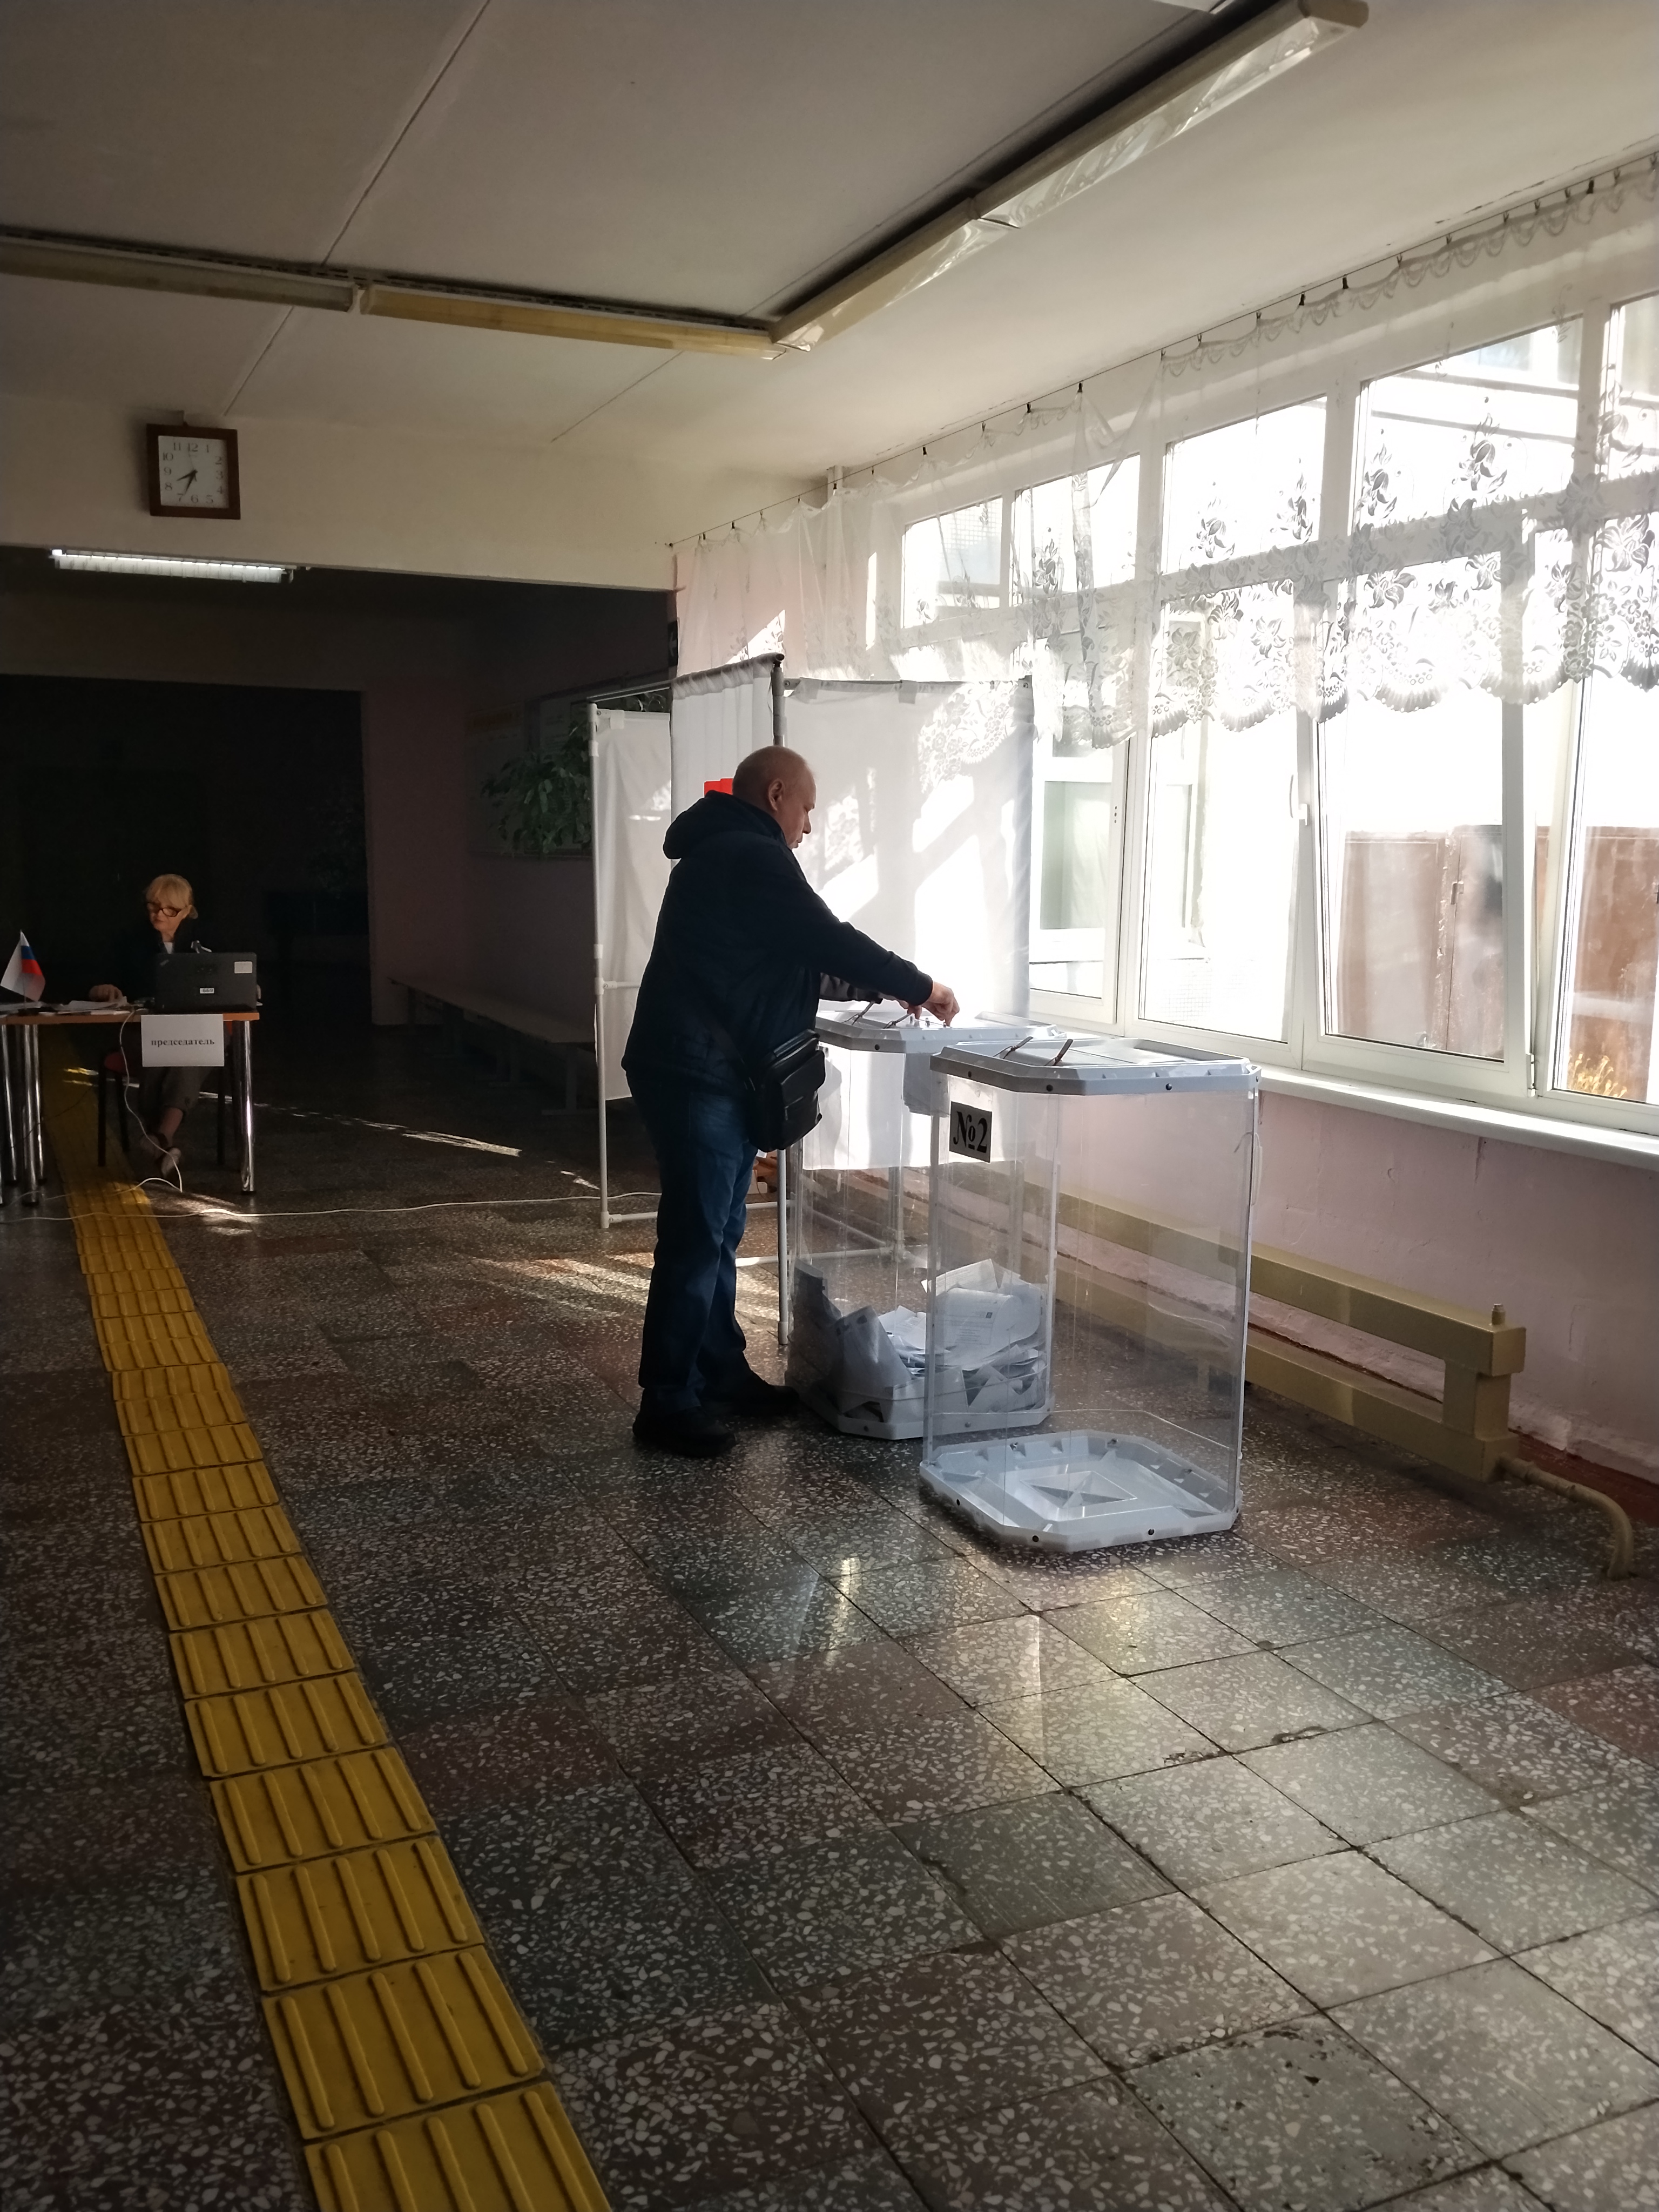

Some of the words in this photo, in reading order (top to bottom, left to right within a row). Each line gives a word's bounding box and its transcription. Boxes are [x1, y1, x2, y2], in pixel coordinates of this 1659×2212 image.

[173, 442, 181, 450] 11
[188, 443, 198, 452] 12
[206, 444, 209, 453] 1
[163, 452, 173, 461] 10
[215, 456, 222, 464] 2
[164, 467, 172, 476] 9
[216, 470, 223, 480] 3
[165, 482, 172, 491] 8
[217, 486, 223, 494] 4
[177, 493, 184, 502] 7
[191, 494, 199, 504] 6
[206, 495, 213, 504] 5
[151, 1039, 215, 1047] председатель
